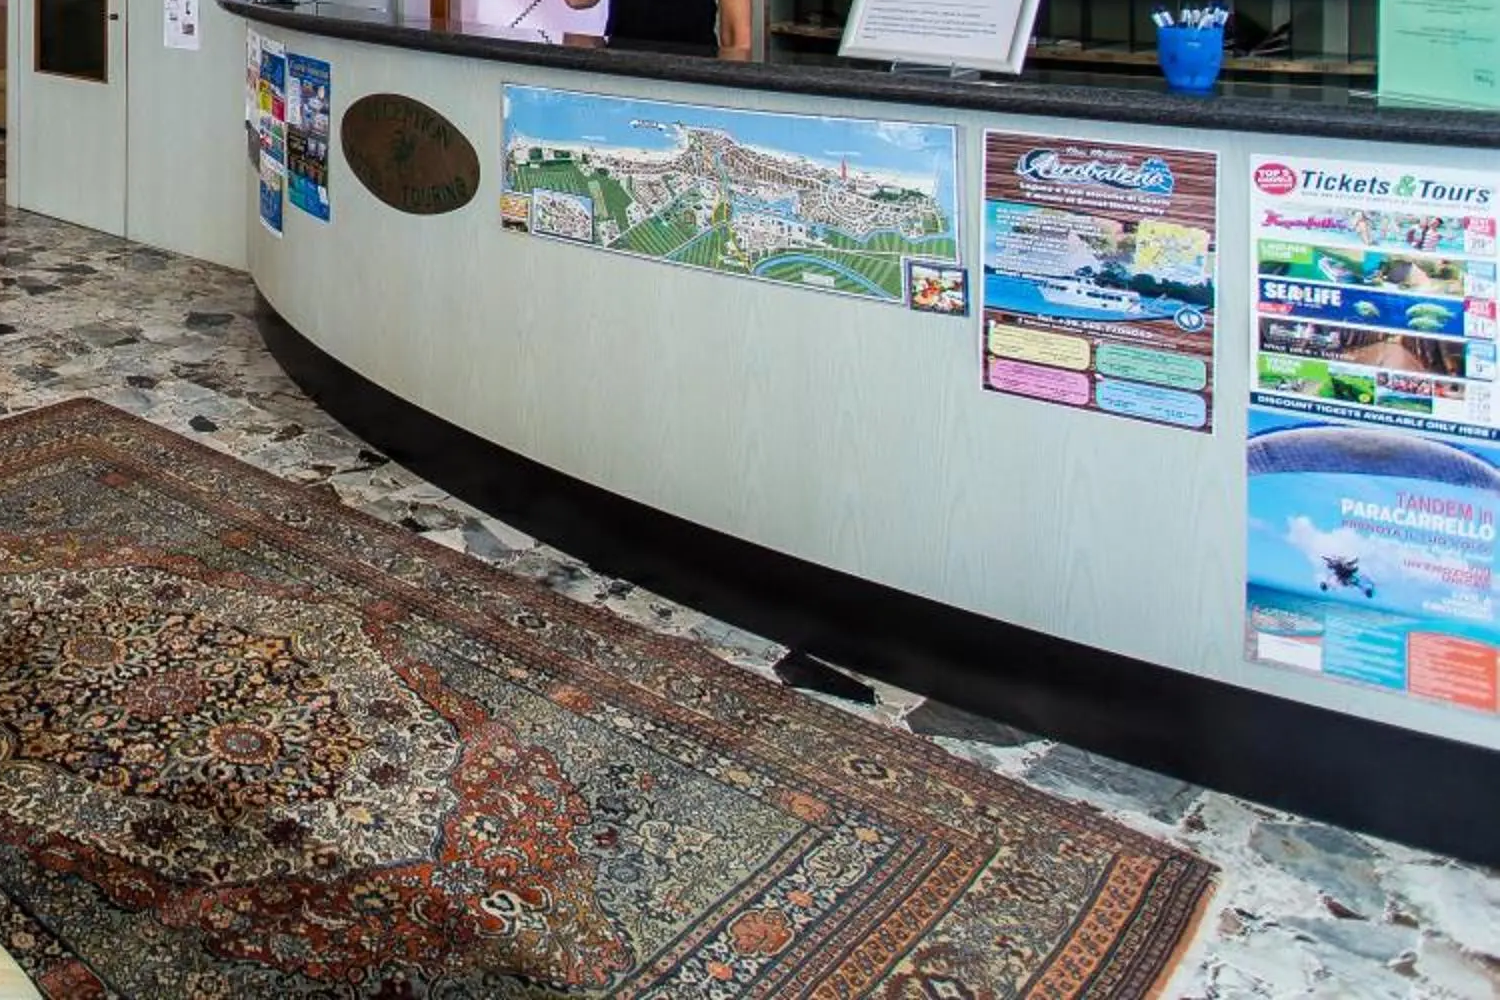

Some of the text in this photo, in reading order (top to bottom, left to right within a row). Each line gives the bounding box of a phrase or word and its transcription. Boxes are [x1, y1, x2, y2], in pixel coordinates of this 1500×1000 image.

[1301, 169, 1391, 196] Tickets
[1392, 174, 1417, 198] &
[1418, 179, 1492, 205] Tours
[1264, 281, 1342, 307] SEA LIFE
[1257, 394, 1313, 411] DISCOUNT
[1316, 403, 1362, 419] TICKETS
[1363, 411, 1424, 429] AVAILABLE
[1426, 420, 1457, 433] ONLY
[1459, 424, 1490, 438] HERE
[1340, 498, 1496, 541] PARACARRELLO
[1396, 491, 1473, 521] TANDEM
